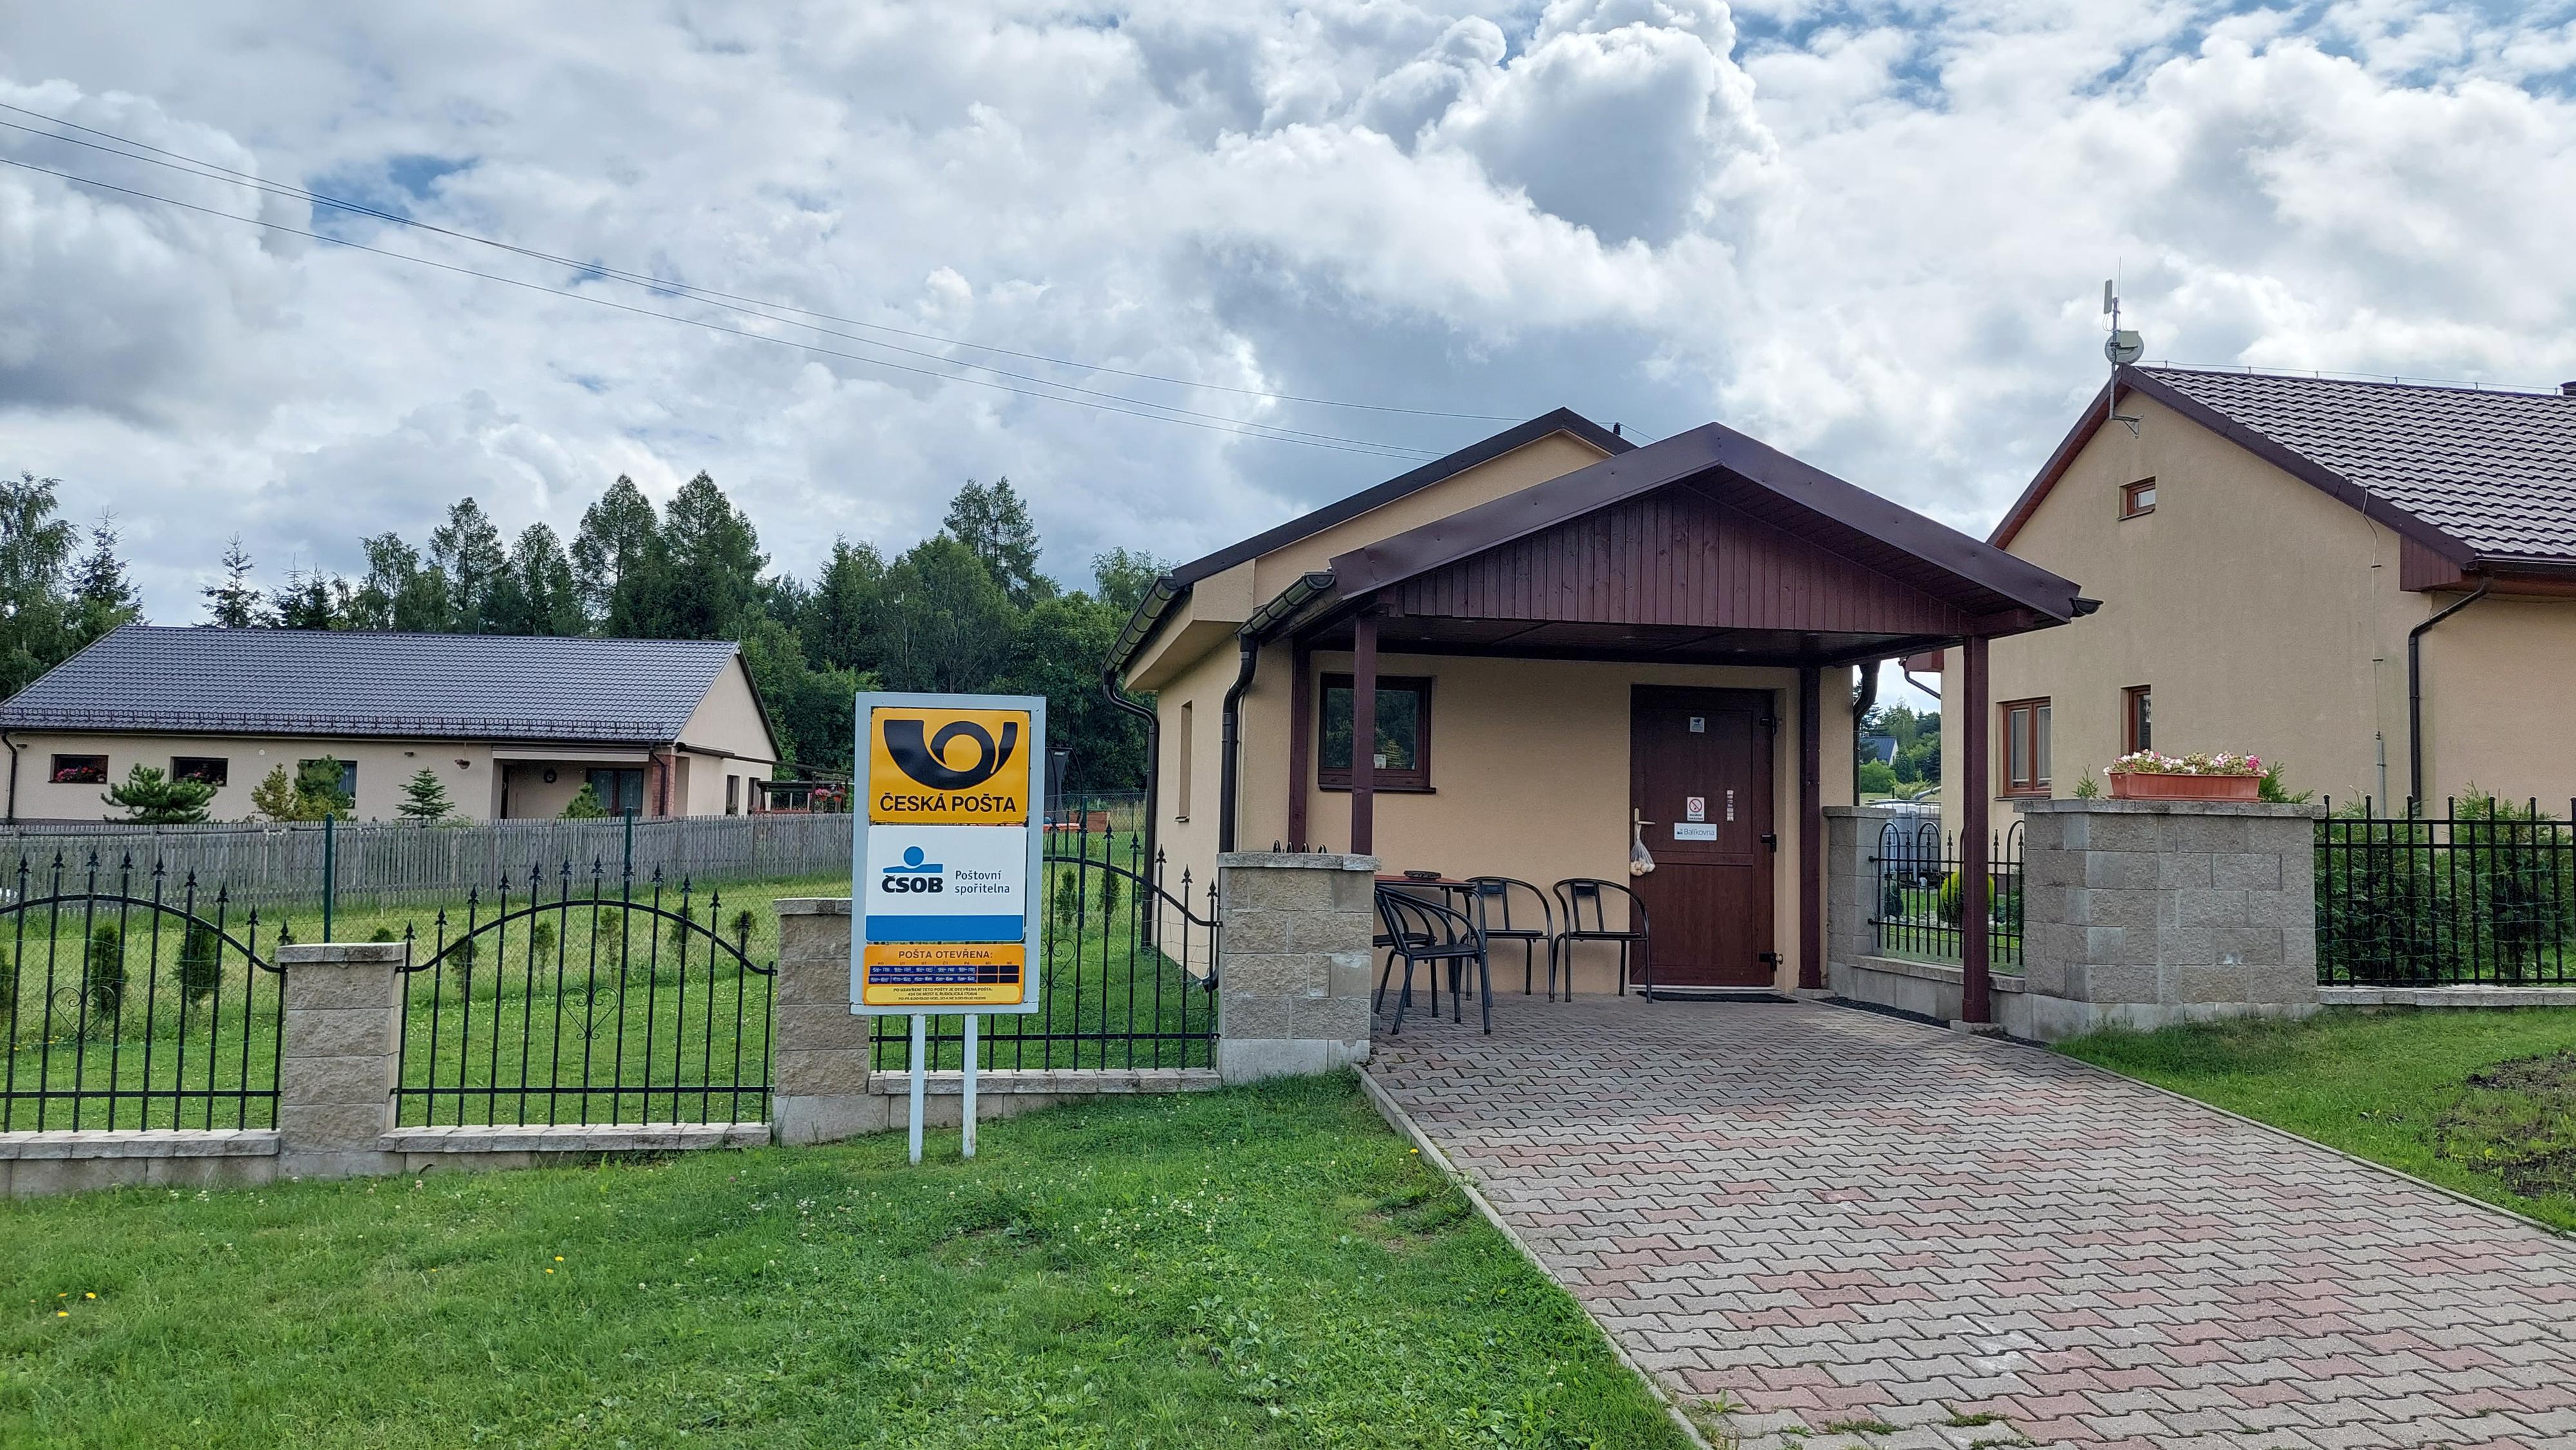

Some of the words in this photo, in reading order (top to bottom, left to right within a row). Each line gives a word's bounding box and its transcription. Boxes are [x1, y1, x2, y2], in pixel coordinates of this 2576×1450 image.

[880, 793, 947, 812] ČESKÁ
[951, 793, 1017, 813] POŠTA
[955, 870, 1001, 880] Poštovní
[882, 874, 943, 893] ČSOB
[954, 883, 1010, 895] spořitelna
[898, 949, 933, 959] POŠTA
[936, 949, 993, 959] OTEVŘENA:
